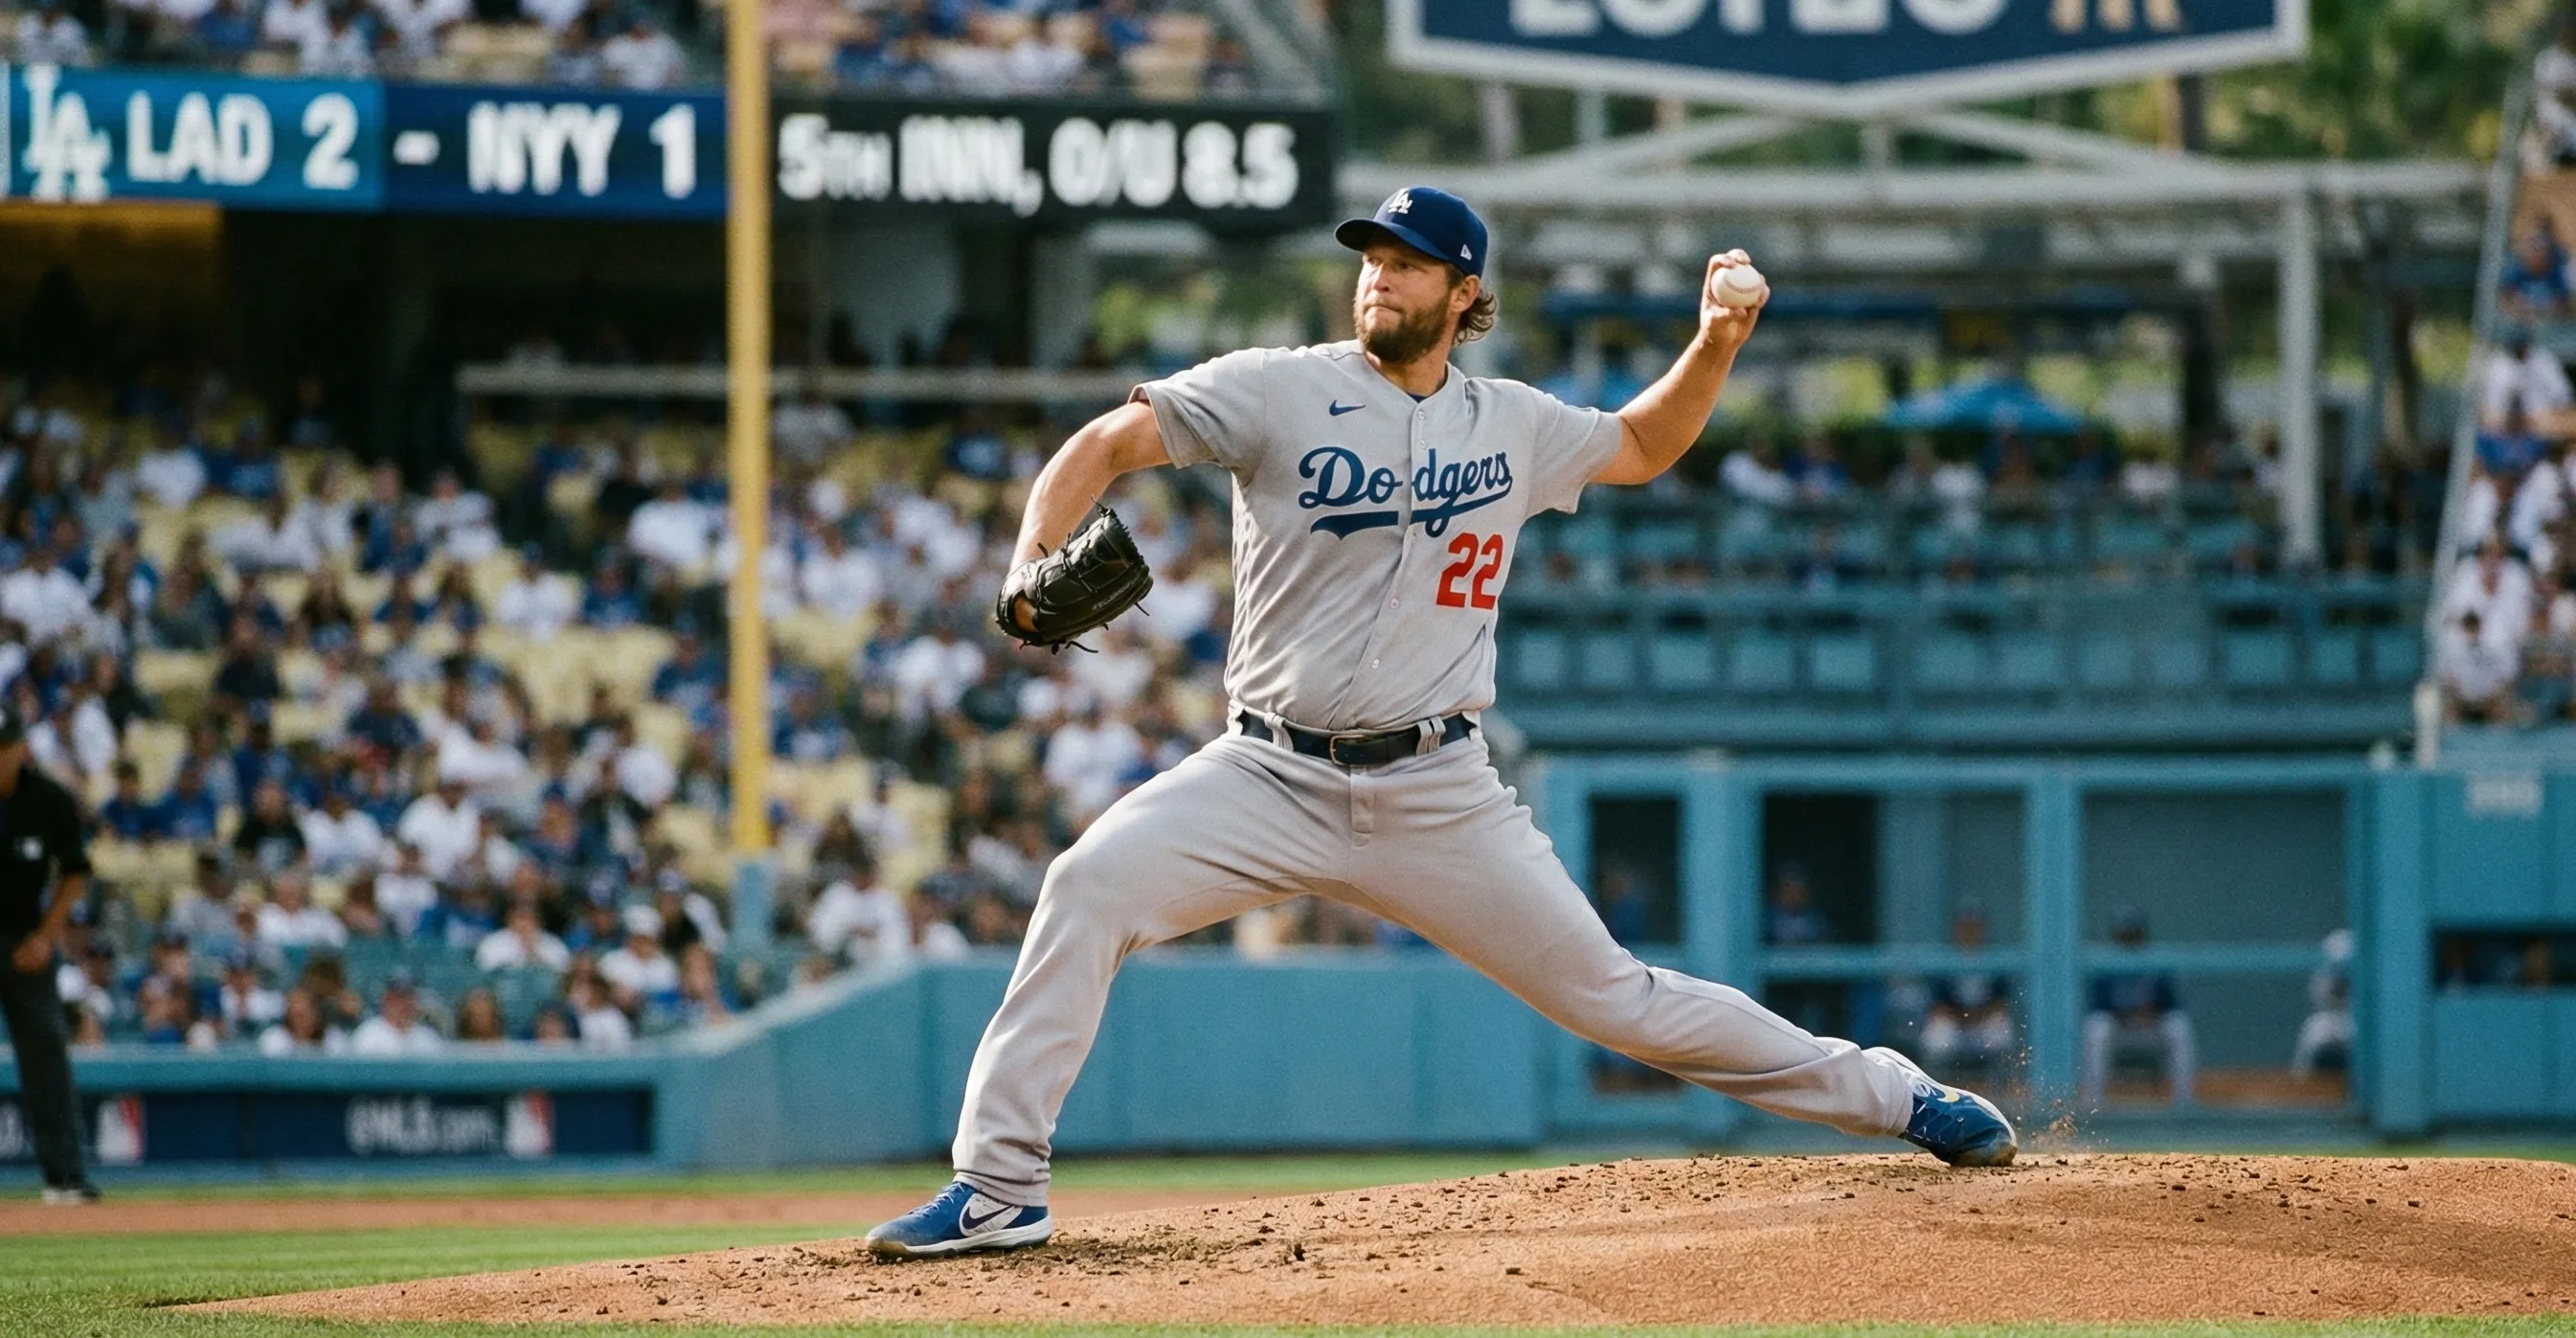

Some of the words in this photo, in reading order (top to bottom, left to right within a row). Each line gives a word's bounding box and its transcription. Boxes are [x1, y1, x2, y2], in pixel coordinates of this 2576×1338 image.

[126, 91, 273, 185] LAD
[302, 93, 358, 190] 2
[467, 102, 621, 195] NYY
[650, 103, 695, 198] 1
[1182, 122, 1299, 209] 8.5
[1388, 188, 1413, 215] LA
[1299, 446, 1513, 538] Dodgers
[1436, 532, 1503, 610] 22
